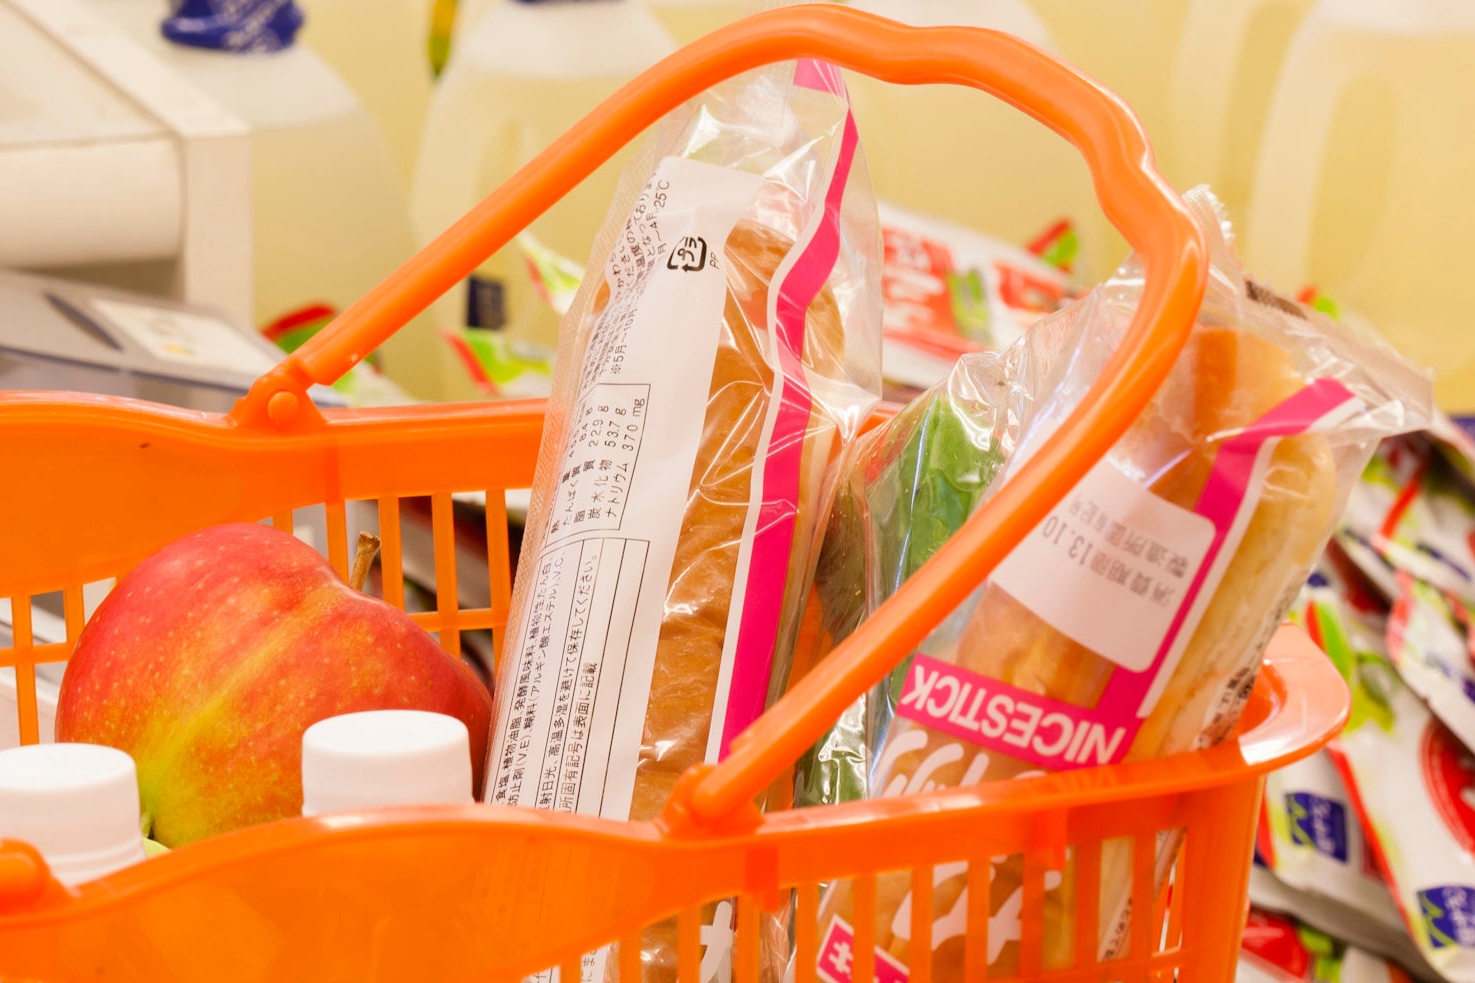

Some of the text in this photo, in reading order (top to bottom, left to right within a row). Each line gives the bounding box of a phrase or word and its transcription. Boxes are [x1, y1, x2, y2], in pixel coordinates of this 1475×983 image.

[605, 399, 645, 518] ナトリウム 370 mg
[560, 662, 598, 814] 所固有記号は表面に記載
[901, 664, 1126, 765] NICESTICK
